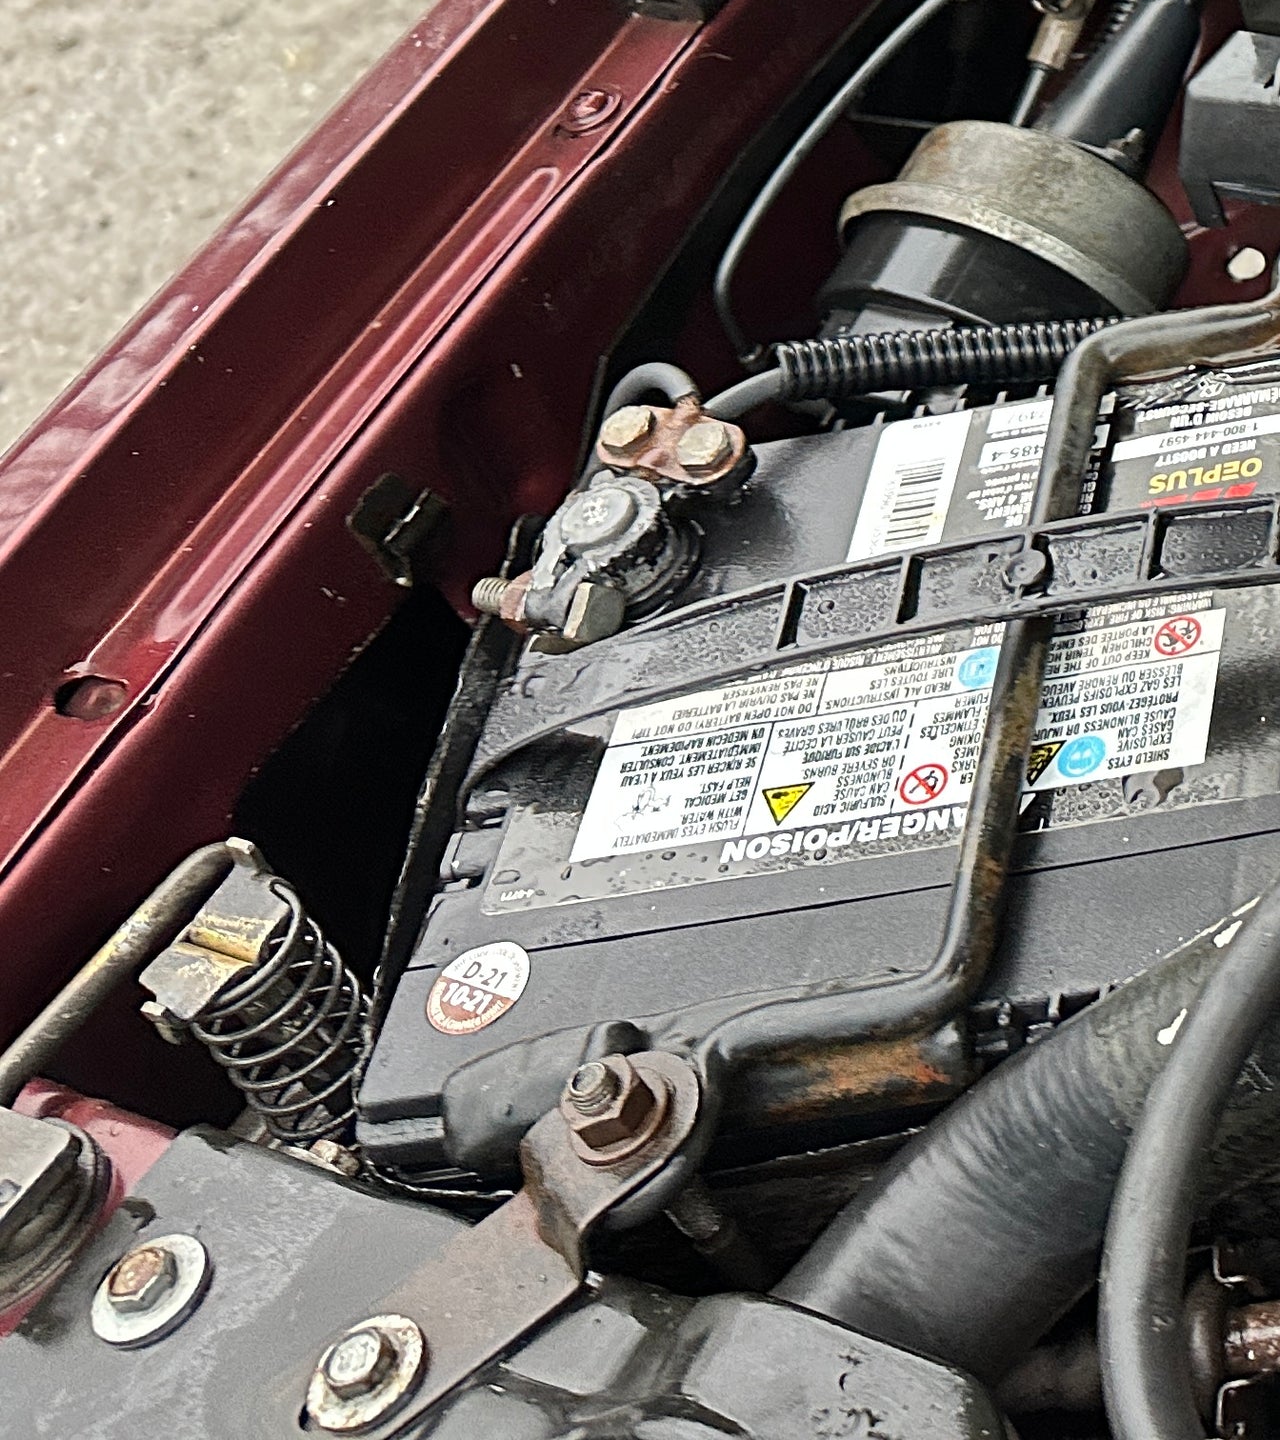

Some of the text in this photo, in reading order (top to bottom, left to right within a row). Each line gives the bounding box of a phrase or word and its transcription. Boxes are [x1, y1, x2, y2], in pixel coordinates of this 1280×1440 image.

[1169, 405, 1251, 429] BESOIN D'UN
[990, 443, 1043, 461] 485-4
[1208, 445, 1219, 456] A
[1221, 438, 1256, 454] NEED
[1129, 605, 1166, 620] RISK OF
[1141, 624, 1154, 635] LA
[1077, 634, 1098, 646] DES
[1063, 648, 1150, 672] KEEP OUT OF THE
[1064, 646, 1094, 660] TENIR
[868, 666, 955, 689] LIRE TOUTES LES
[1077, 662, 1183, 690] BLESSER OU RENDRE
[721, 675, 819, 700] NE PAS RENVERSER
[779, 690, 800, 703] PAS
[802, 688, 816, 699] NE
[901, 684, 922, 696] ALL
[922, 680, 951, 693] READ
[1082, 674, 1181, 702] LES GAZ EXPLOSIFS
[722, 700, 736, 711] LA
[737, 693, 778, 709] OUVRIR
[953, 692, 990, 708] FUMER
[653, 701, 813, 736] DO NOT OPEN DO NOT
[1079, 704, 1097, 717] LES
[773, 708, 908, 739] OU DES GRAVES.
[1065, 706, 1176, 736] CAUSE BLINDNESS OR
[1116, 719, 1174, 739] GASES CAN
[749, 727, 765, 740] UN
[819, 724, 904, 747] PEUT CAUSER LA
[1116, 731, 1172, 752] EXPLOSIVE
[862, 738, 901, 754] L'ACIDE
[618, 754, 675, 773] CONSULTER
[1134, 748, 1170, 765] SHIELD
[619, 756, 757, 787] SE RINCER LES YEUX L'EAU
[798, 755, 896, 779] OR SEVERE BURNS.
[835, 767, 893, 787] BLINDNESS
[696, 775, 752, 794] HELP FAST.
[832, 781, 890, 800] CAN CAUSE
[681, 788, 748, 808] GET MEDICAL
[812, 795, 887, 816] SULFURIC ACID
[677, 805, 743, 825] WITH WATER.
[611, 818, 740, 848] FLUSH EYES IMMEDIATELY
[719, 803, 967, 864] ANGER/POISON
[462, 961, 509, 989] D-21
[441, 981, 494, 1016] 10-21
